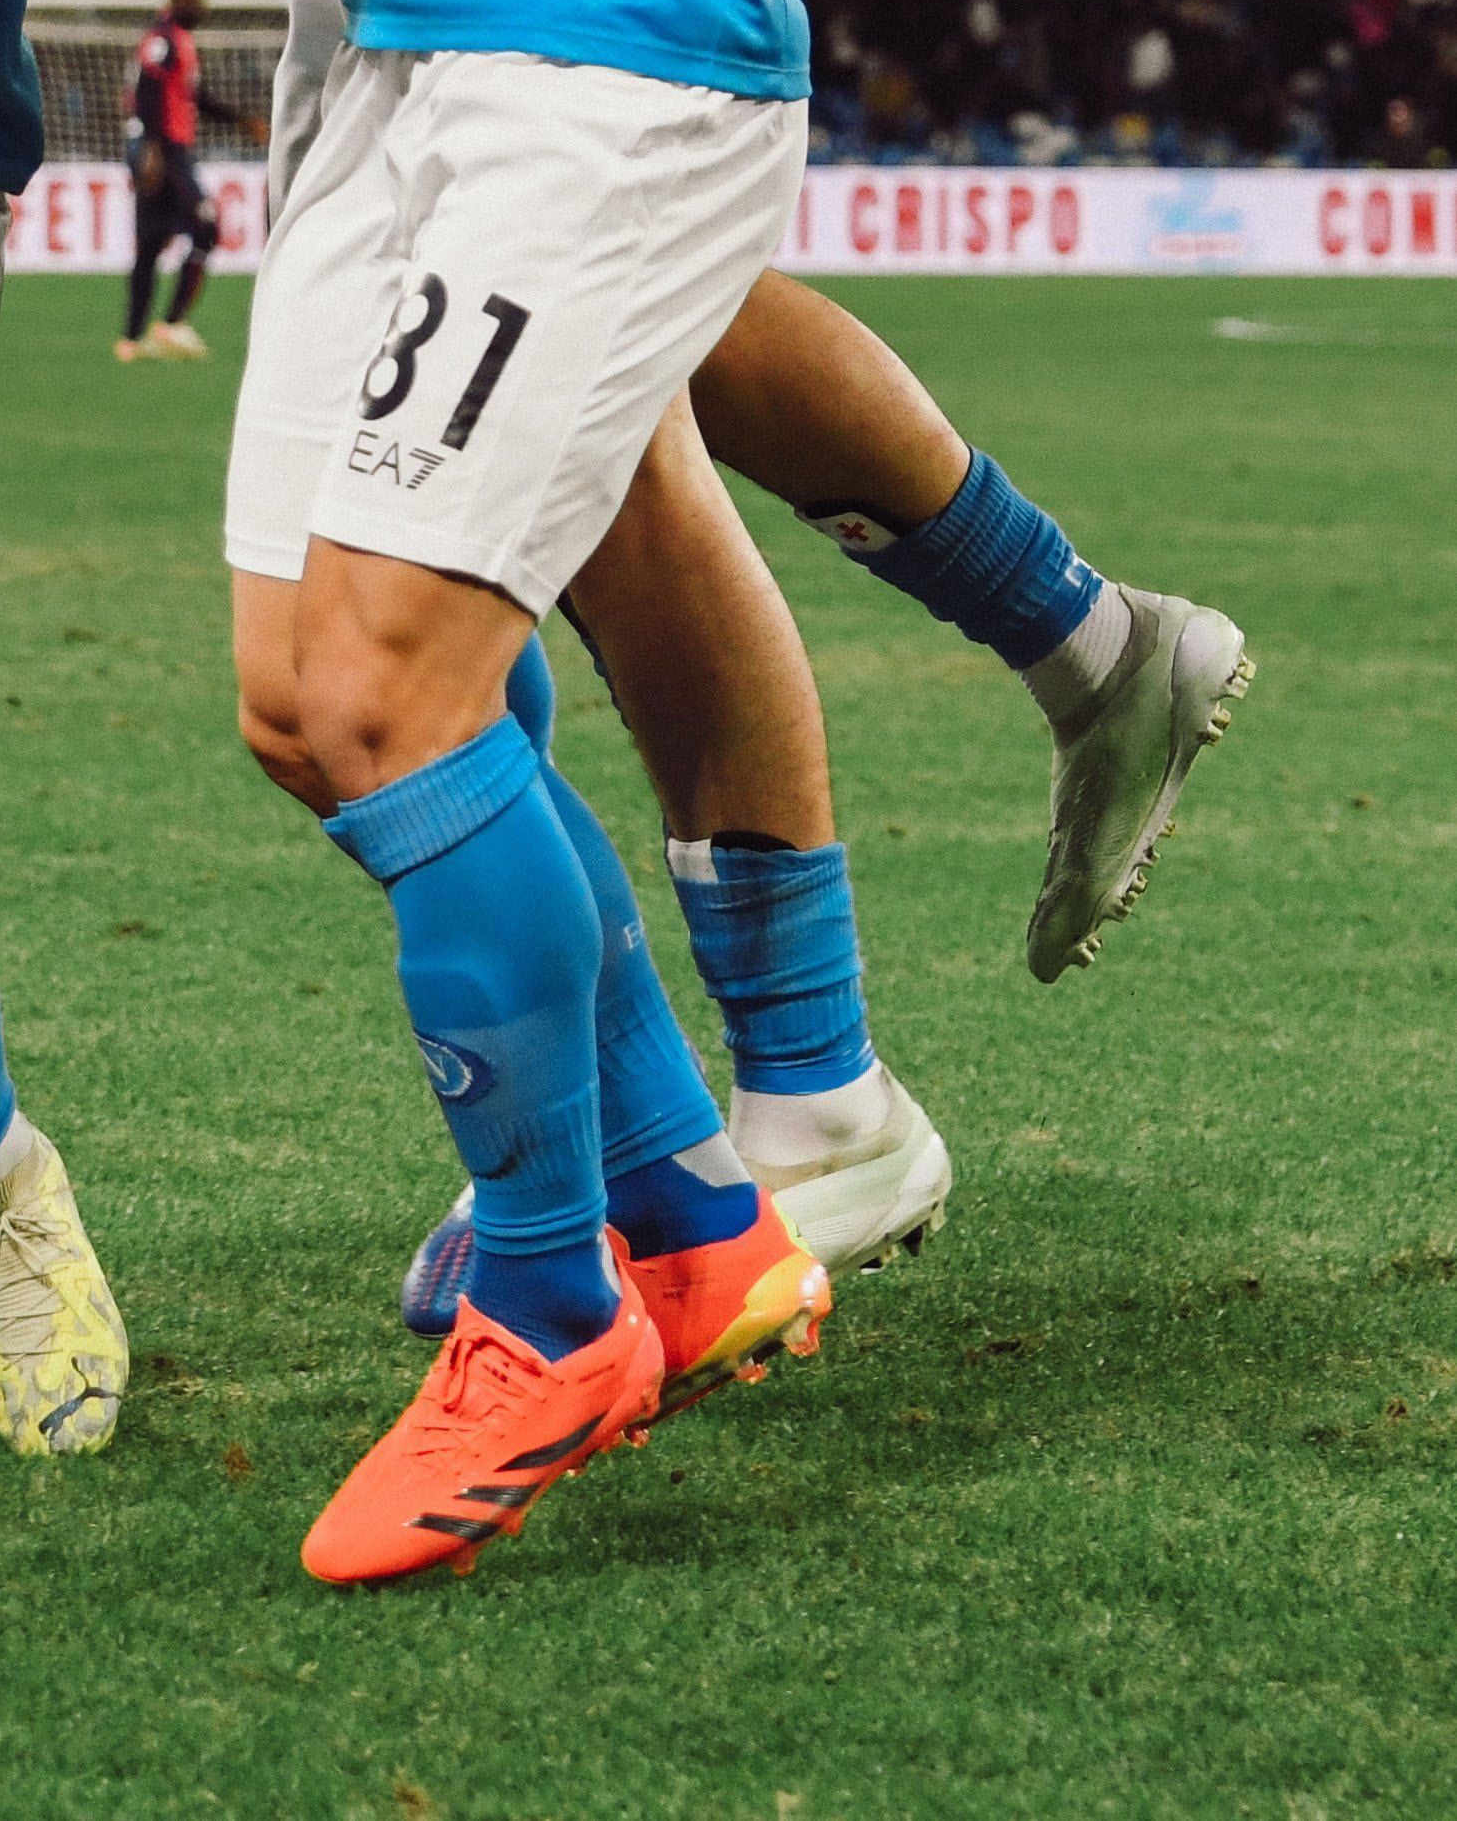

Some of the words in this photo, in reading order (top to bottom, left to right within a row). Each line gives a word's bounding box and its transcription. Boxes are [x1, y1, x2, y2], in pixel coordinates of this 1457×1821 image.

[849, 184, 1080, 254] CRISPO
[357, 271, 533, 454] 81
[347, 428, 447, 491] EA7
